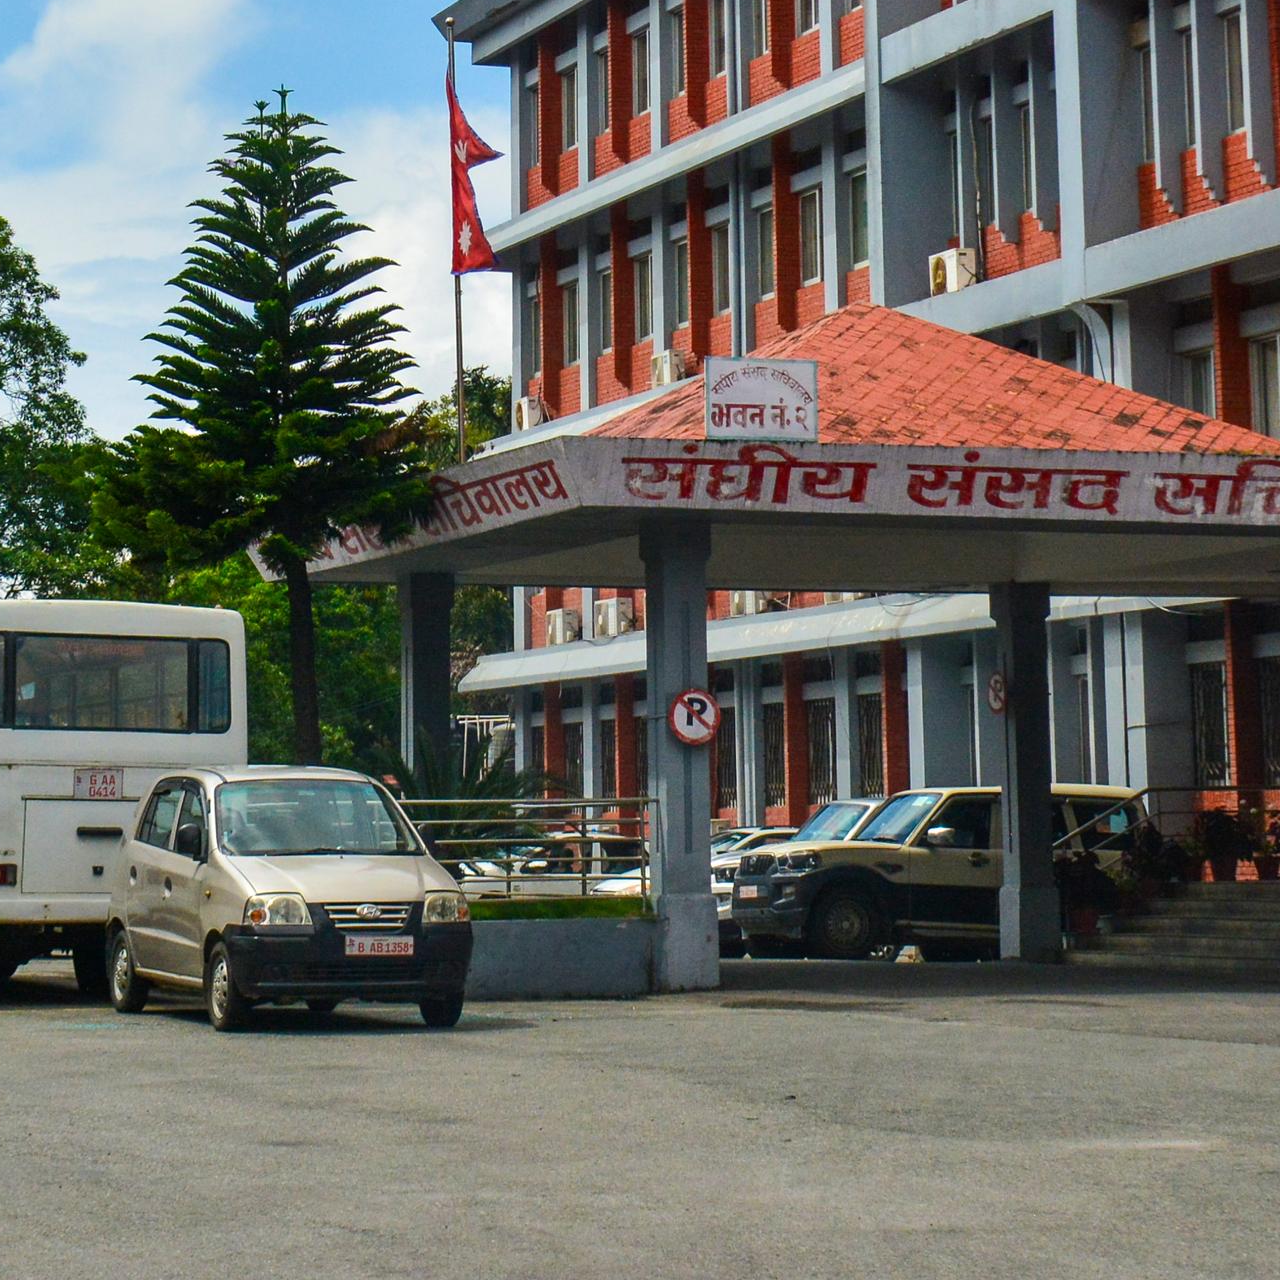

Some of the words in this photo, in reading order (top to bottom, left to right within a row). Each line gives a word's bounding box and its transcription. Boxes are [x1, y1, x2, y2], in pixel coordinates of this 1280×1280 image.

[711, 403, 766, 428] भवन
[795, 406, 809, 431] २
[621, 443, 877, 504] संघीय
[907, 451, 1130, 515] संसद
